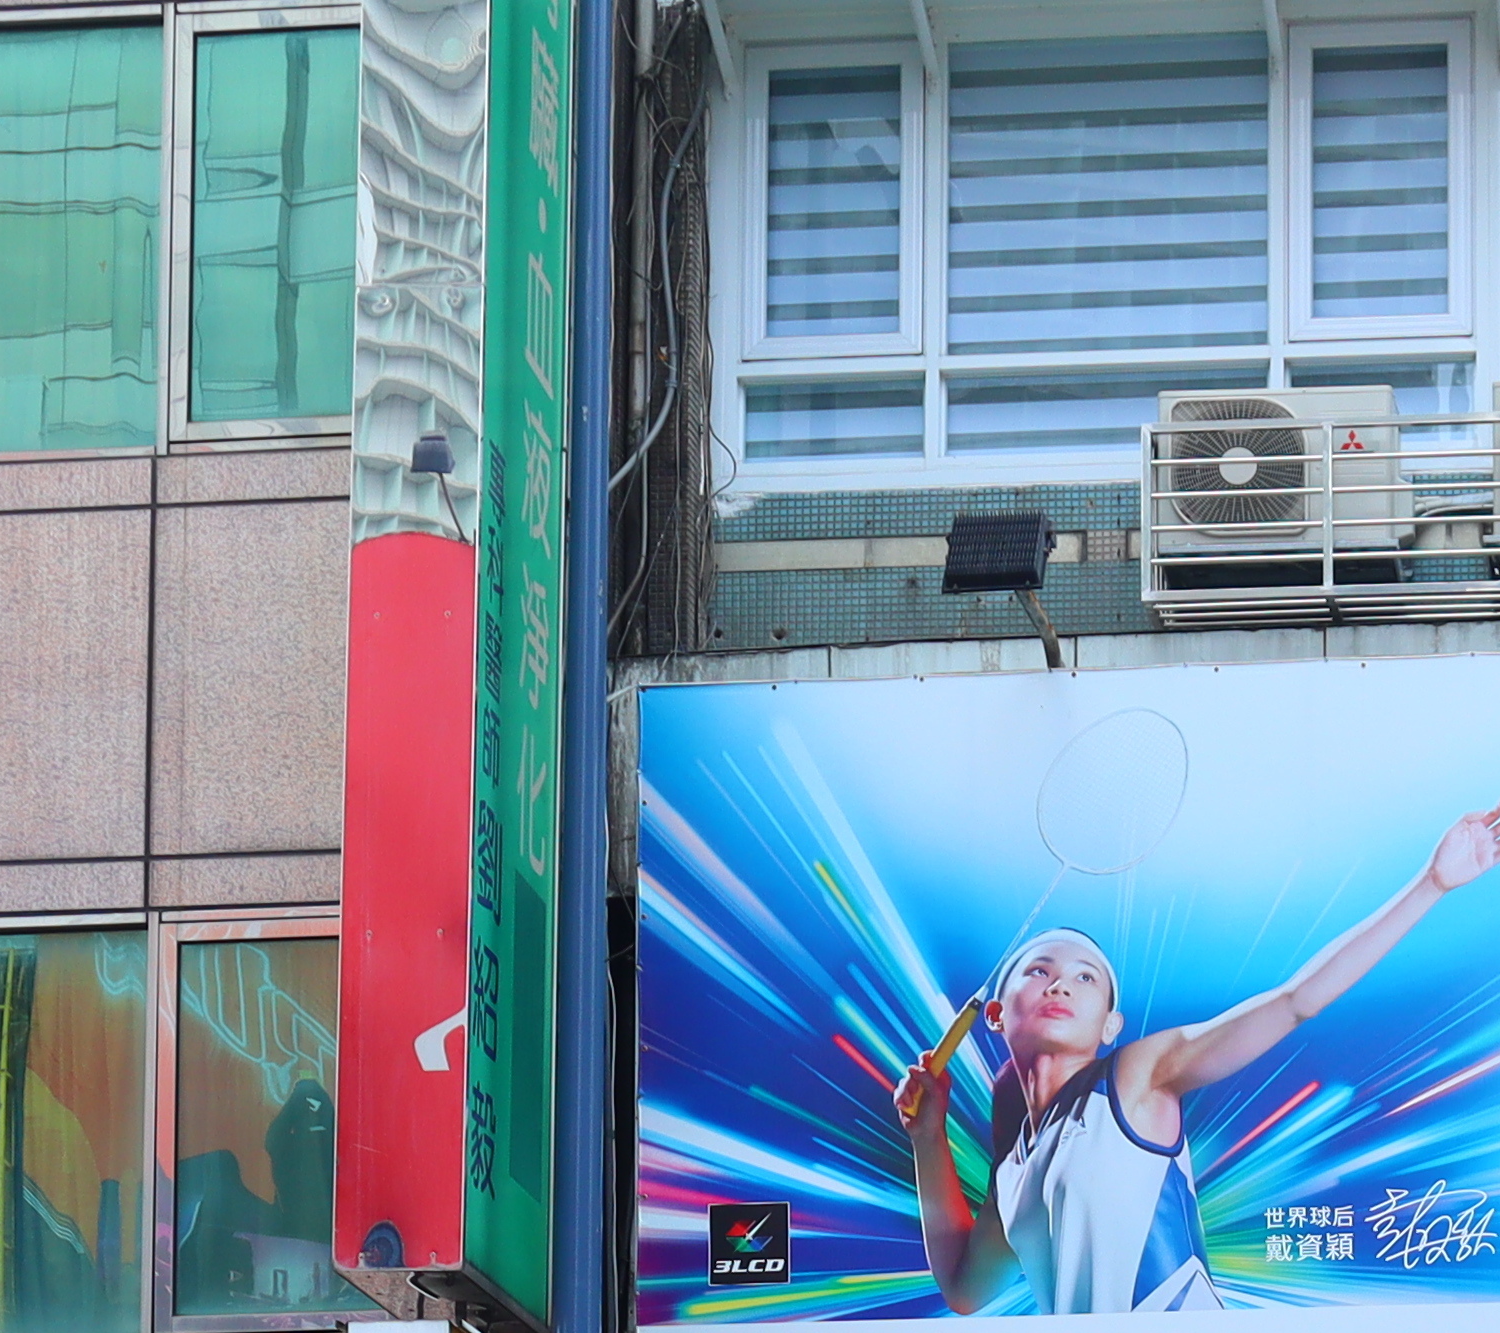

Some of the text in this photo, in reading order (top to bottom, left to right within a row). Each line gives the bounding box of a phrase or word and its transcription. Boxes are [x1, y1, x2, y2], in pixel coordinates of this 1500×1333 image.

[517, 0, 559, 876] 臟·血液淨化
[469, 439, 507, 1200] 專科醫師劉紹毅
[1264, 1206, 1354, 1229] 世界球后
[1265, 1233, 1354, 1262] 戴資穎
[713, 1257, 786, 1275] 3LCD
